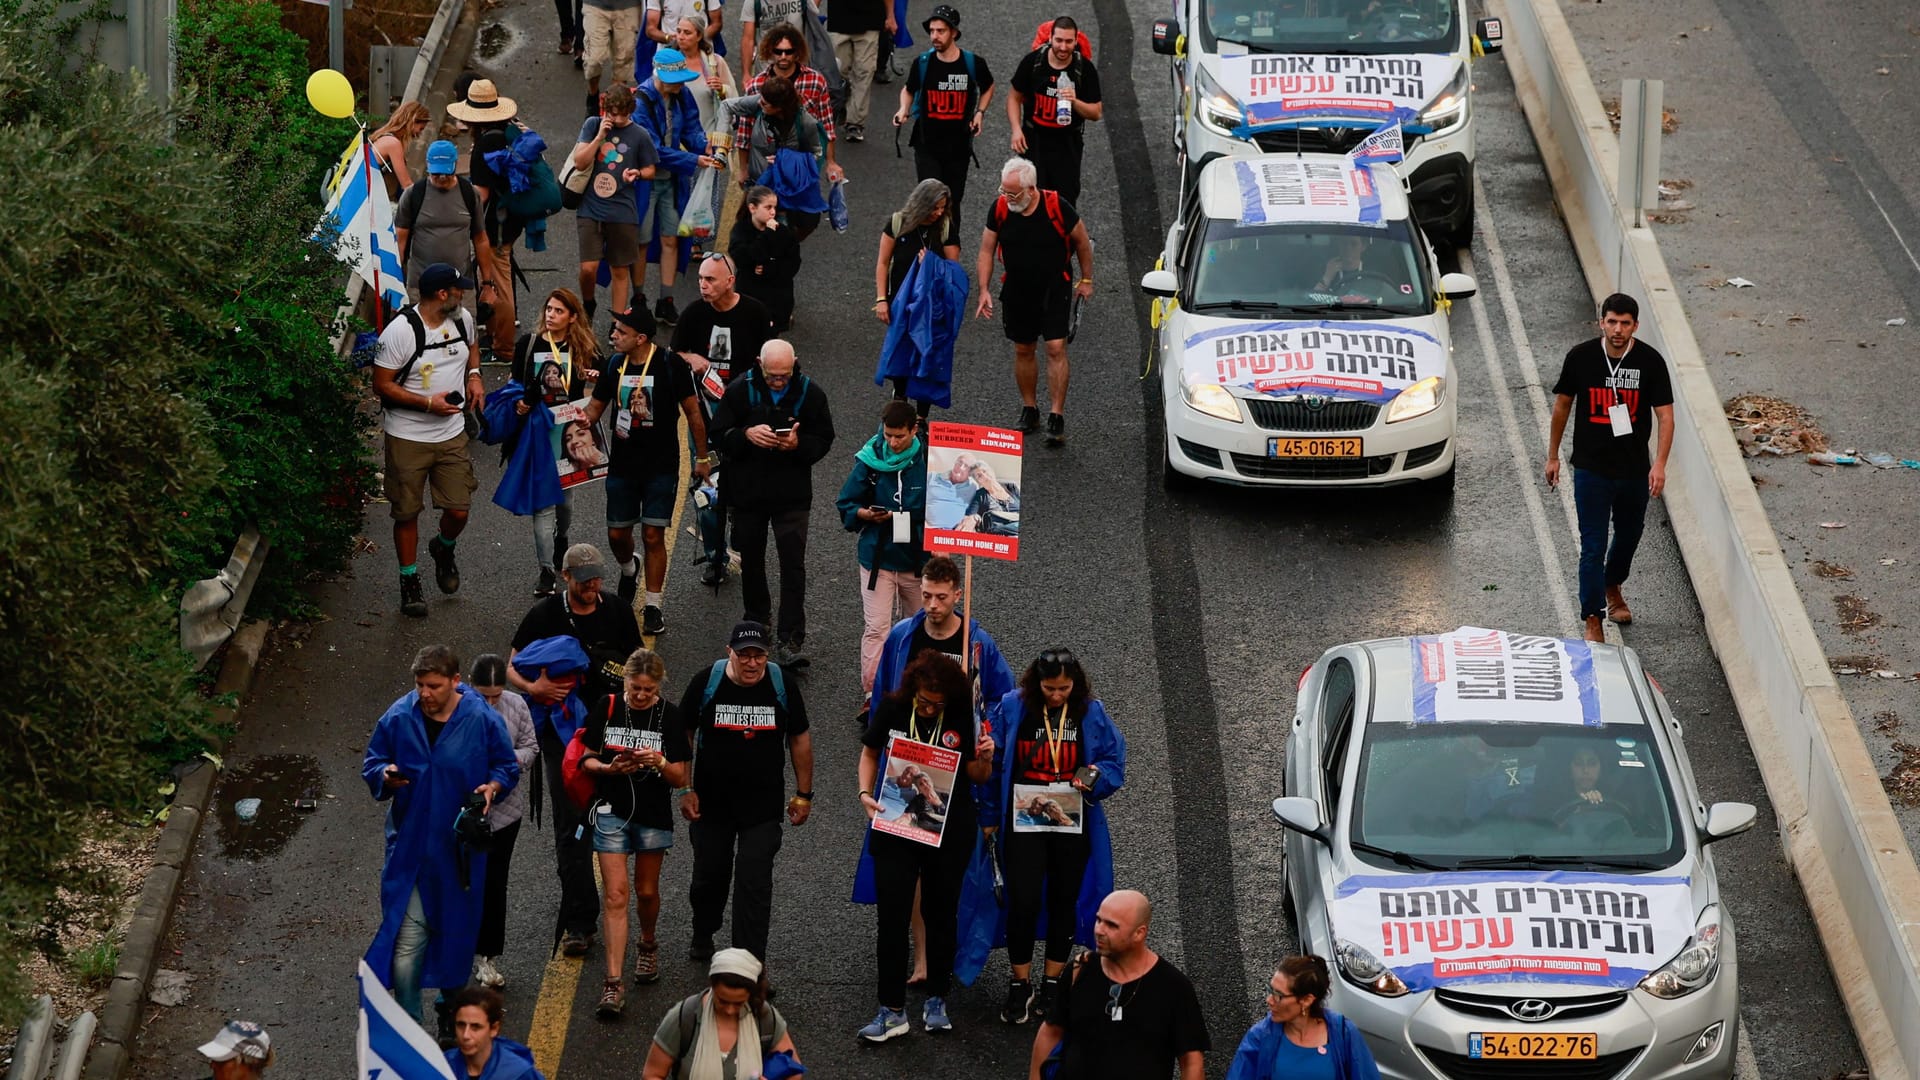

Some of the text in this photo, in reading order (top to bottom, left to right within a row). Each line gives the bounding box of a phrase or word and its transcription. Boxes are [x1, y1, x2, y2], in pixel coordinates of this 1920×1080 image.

[1251, 57, 1422, 76] מחזירים אותם
[1251, 75, 1424, 99] הביתה עכשיו!
[1216, 330, 1415, 359] מחזירים אותם
[1216, 352, 1417, 383] הביתה עכשיו!
[980, 439, 1021, 450] KIDNAPPED
[933, 536, 1009, 553] BRING THEM HOME NOW
[1456, 661, 1507, 700] הביתה
[715, 704, 775, 715] HOSTAGES AND MISSING
[715, 713, 776, 727] FAMILIES FORUM
[605, 734, 662, 752] FAMILIES FORUM
[1379, 887, 1650, 920] מחזירים אותם
[1382, 917, 1655, 957] הביתה עכשיו!
[1440, 958, 1601, 973] מטה המשפחות להחזרת החטופים והנעדרים
